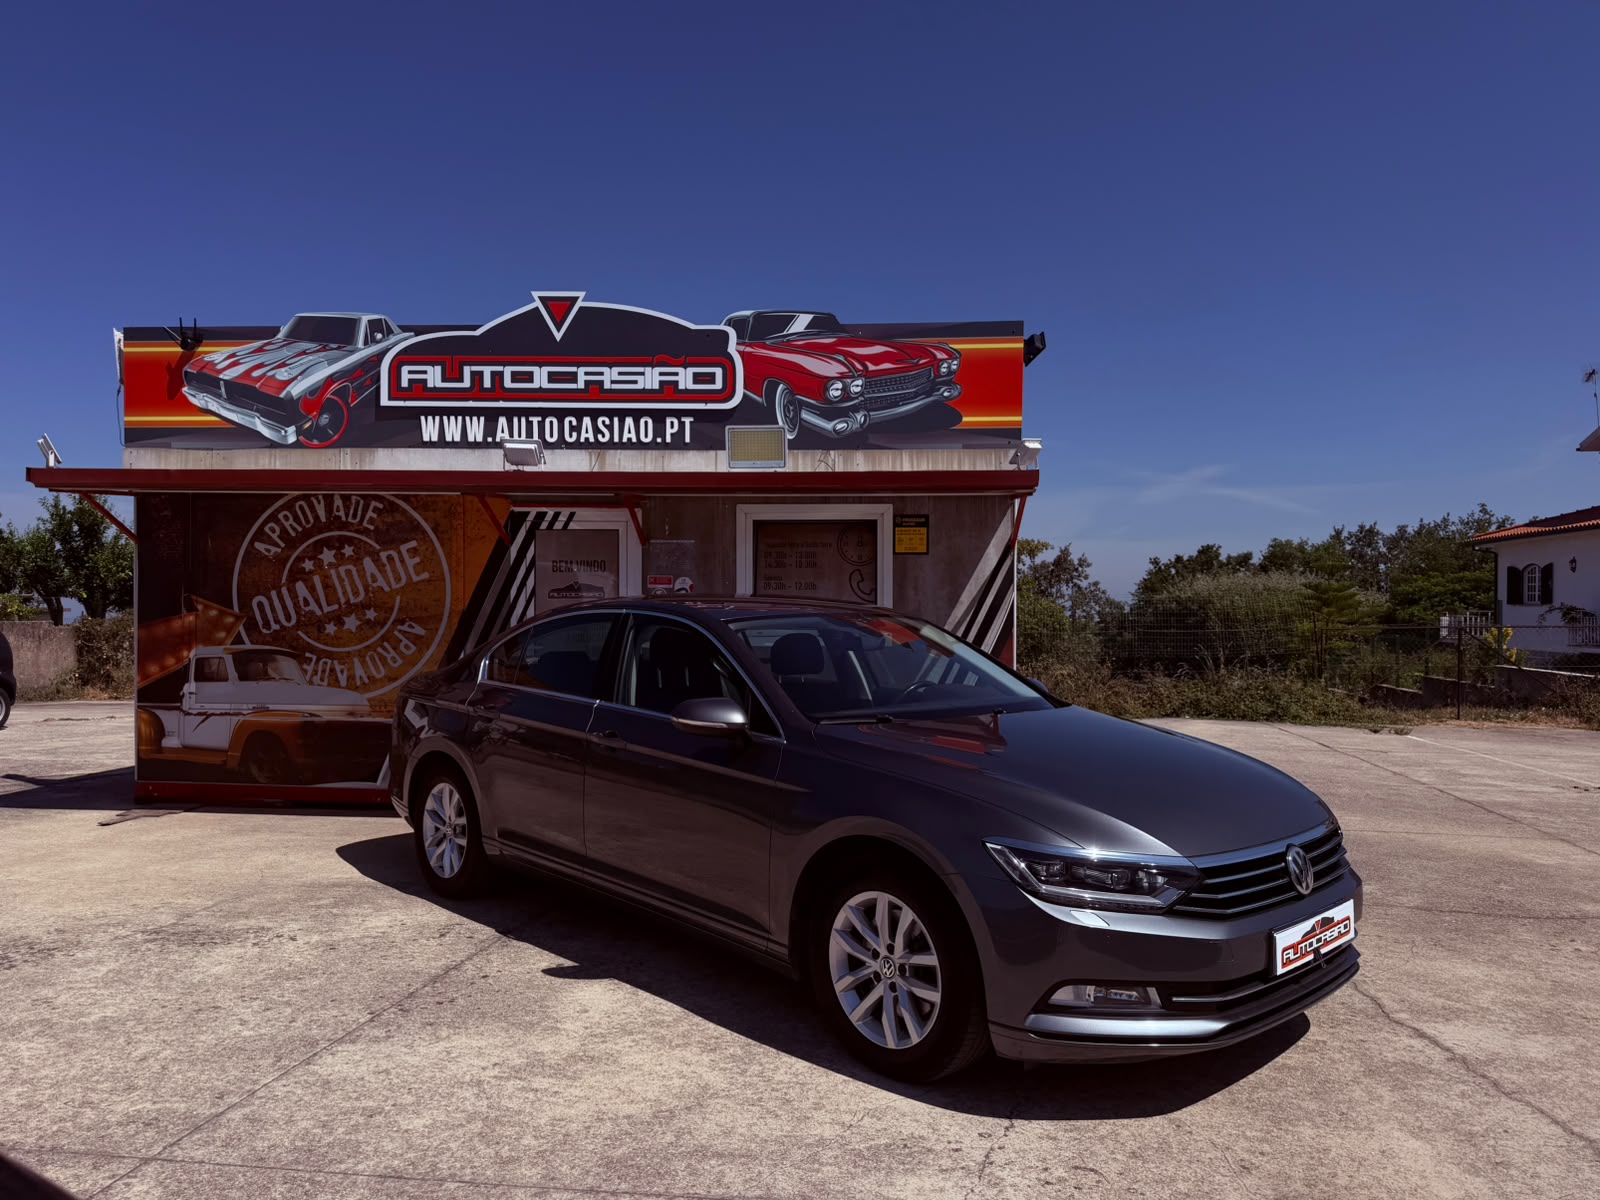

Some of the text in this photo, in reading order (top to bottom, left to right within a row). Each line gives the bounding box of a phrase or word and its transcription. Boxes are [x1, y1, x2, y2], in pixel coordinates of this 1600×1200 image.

[401, 354, 723, 390] AUTOCASIÃO
[420, 415, 694, 443] WWW.AUTOCASIAO.PT
[254, 494, 384, 558] APROVADE
[552, 559, 606, 573] BEM VINDO
[252, 540, 430, 634] QUALIDADE
